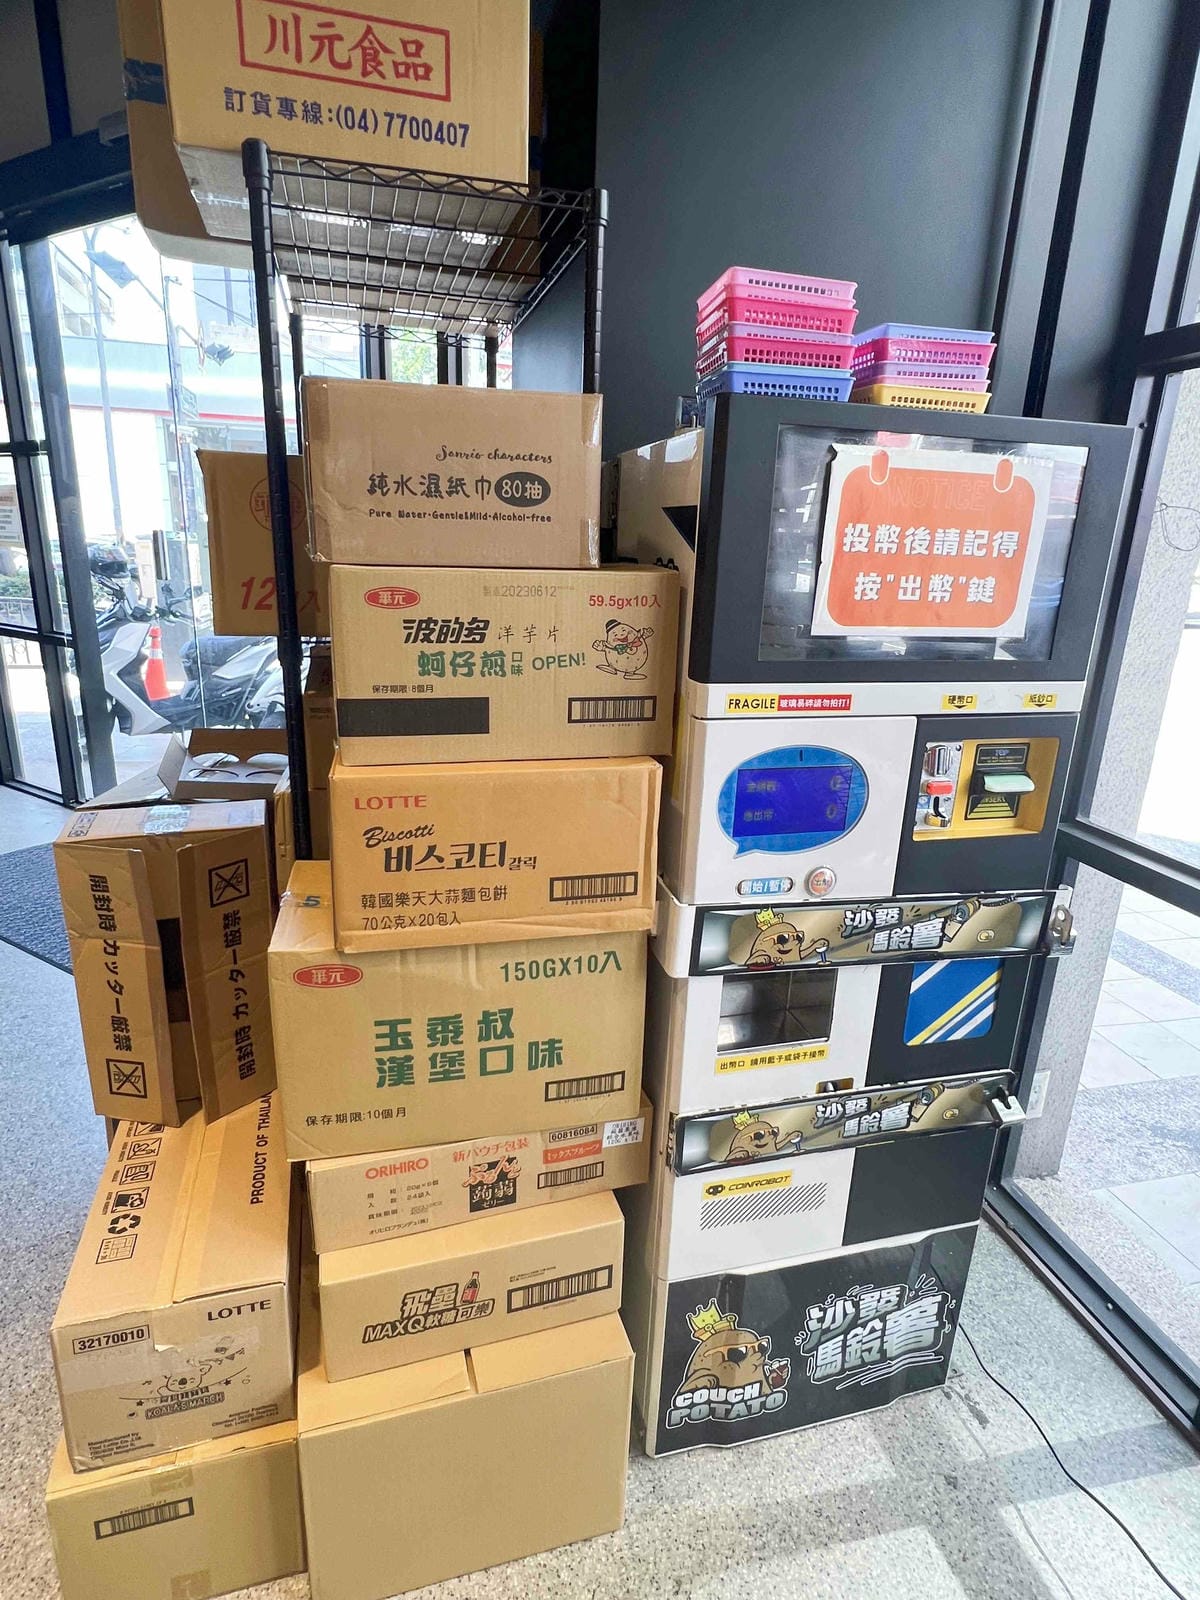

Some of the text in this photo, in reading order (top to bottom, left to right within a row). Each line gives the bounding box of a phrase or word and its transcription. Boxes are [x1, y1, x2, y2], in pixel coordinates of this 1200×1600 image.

[264, 12, 434, 83] 川元食品
[487, 448, 553, 464] characters
[501, 478, 543, 501] 80抽
[369, 508, 391, 519] Pure
[843, 522, 1020, 559] 投幣後請記得
[378, 590, 408, 607] 華元
[589, 594, 662, 609] 59.5gx10入
[402, 616, 560, 645] 波的多 洋芋片
[417, 649, 508, 679] 蚵仔煎
[532, 651, 587, 672] OPEN!
[728, 696, 777, 711] FRAGILE
[947, 693, 974, 706] 硬幣口
[1028, 692, 1054, 705] 紙鈔口
[354, 795, 428, 811] LOTTE
[363, 823, 436, 849] Biscotti
[384, 840, 538, 873] 비스코티 갈릭
[89, 874, 118, 934] 開封時
[842, 906, 903, 939] 沙發
[869, 917, 946, 951] 馬鈴薯
[311, 968, 346, 985] 華元
[500, 950, 623, 983] 150GX10入
[374, 1007, 514, 1053] 玉黍叔
[235, 1025, 257, 1081] 開封時
[376, 1038, 564, 1088] 漢堡口味
[720, 1060, 746, 1071] 出幣口
[814, 1096, 871, 1130] 沙發
[842, 1102, 913, 1139] 馬鈴薯
[257, 1133, 269, 1147] OF
[551, 1125, 595, 1142] 60816084
[250, 1150, 268, 1205] PRODUCT
[365, 1157, 429, 1180] ORIHIRO
[728, 1174, 791, 1192] COINROBOT
[207, 1299, 272, 1321] LOTTE
[806, 1287, 901, 1348] 沙發
[77, 1328, 145, 1351] 32170010
[813, 1294, 944, 1380] 馬鈴薯
[189, 1392, 224, 1409] MARCH
[674, 1381, 762, 1408] COUCH
[669, 1390, 786, 1427] POTATO
